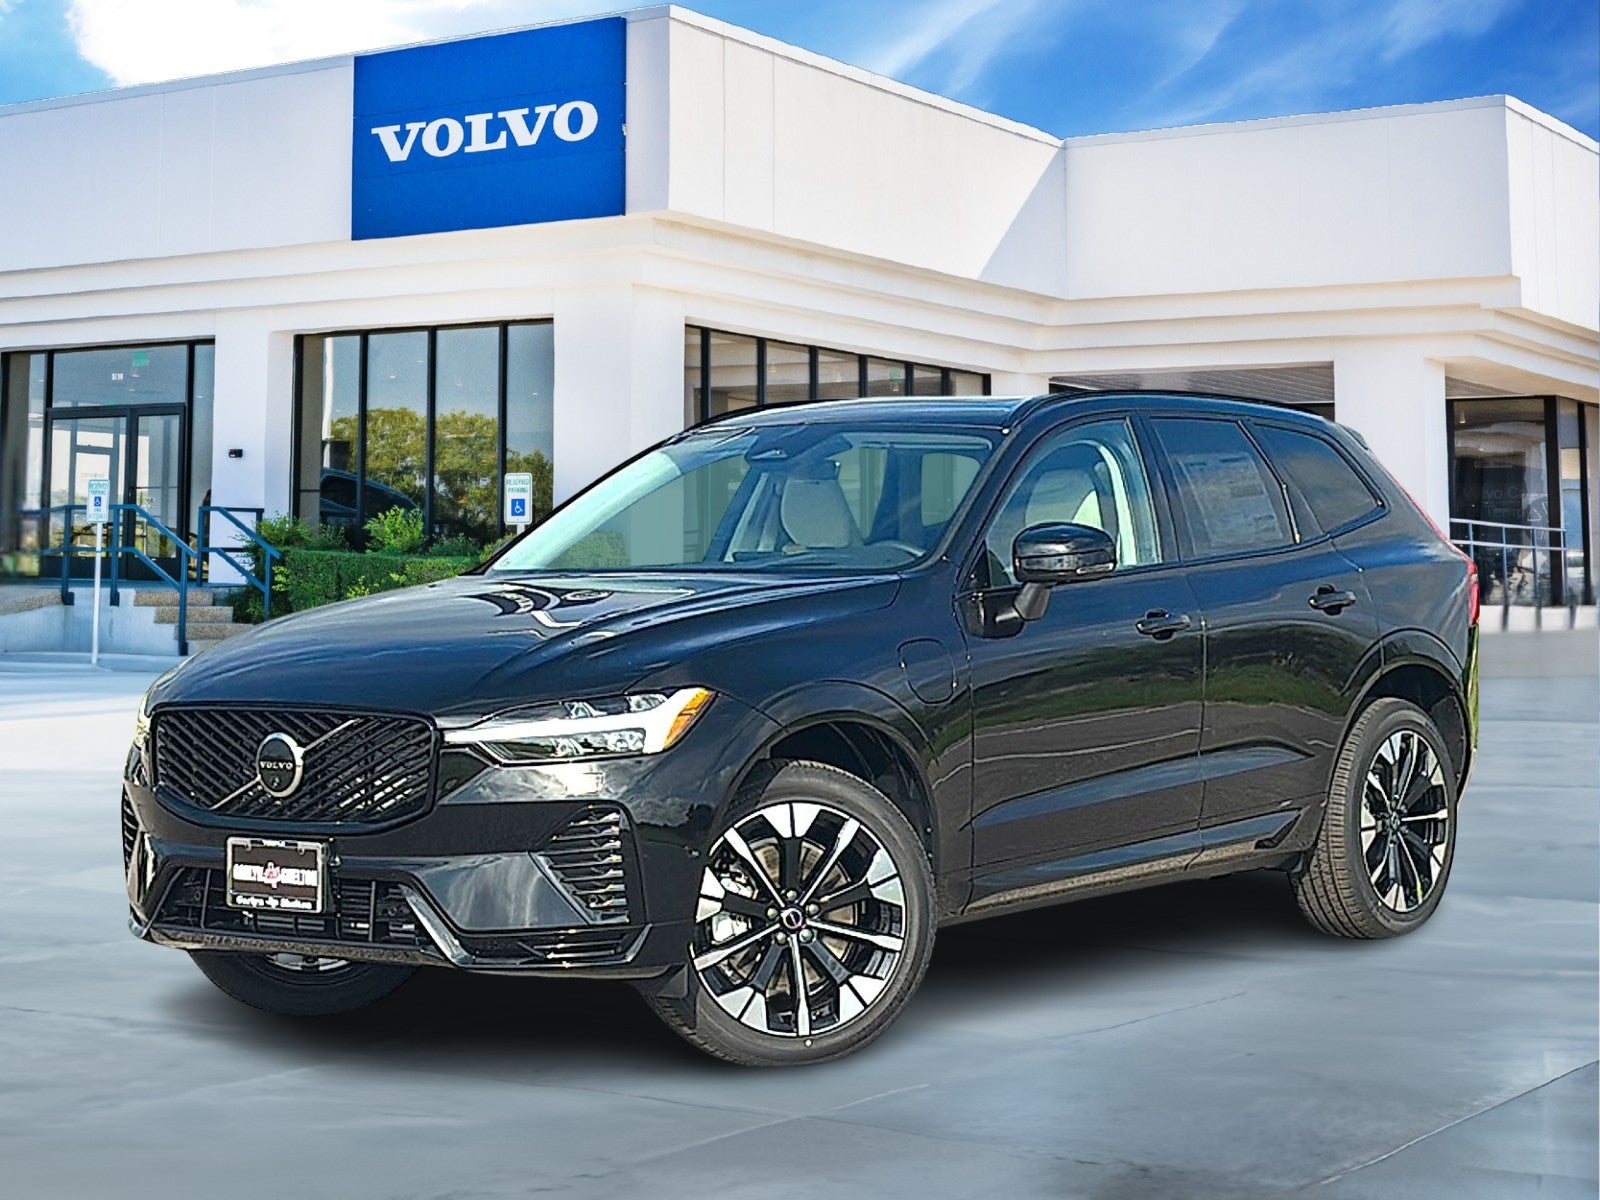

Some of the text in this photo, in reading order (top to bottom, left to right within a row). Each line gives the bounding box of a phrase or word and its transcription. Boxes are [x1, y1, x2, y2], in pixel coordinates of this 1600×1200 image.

[371, 100, 598, 162] VOLVO
[506, 478, 529, 486] RESERVED
[260, 761, 294, 770] VOLVO
